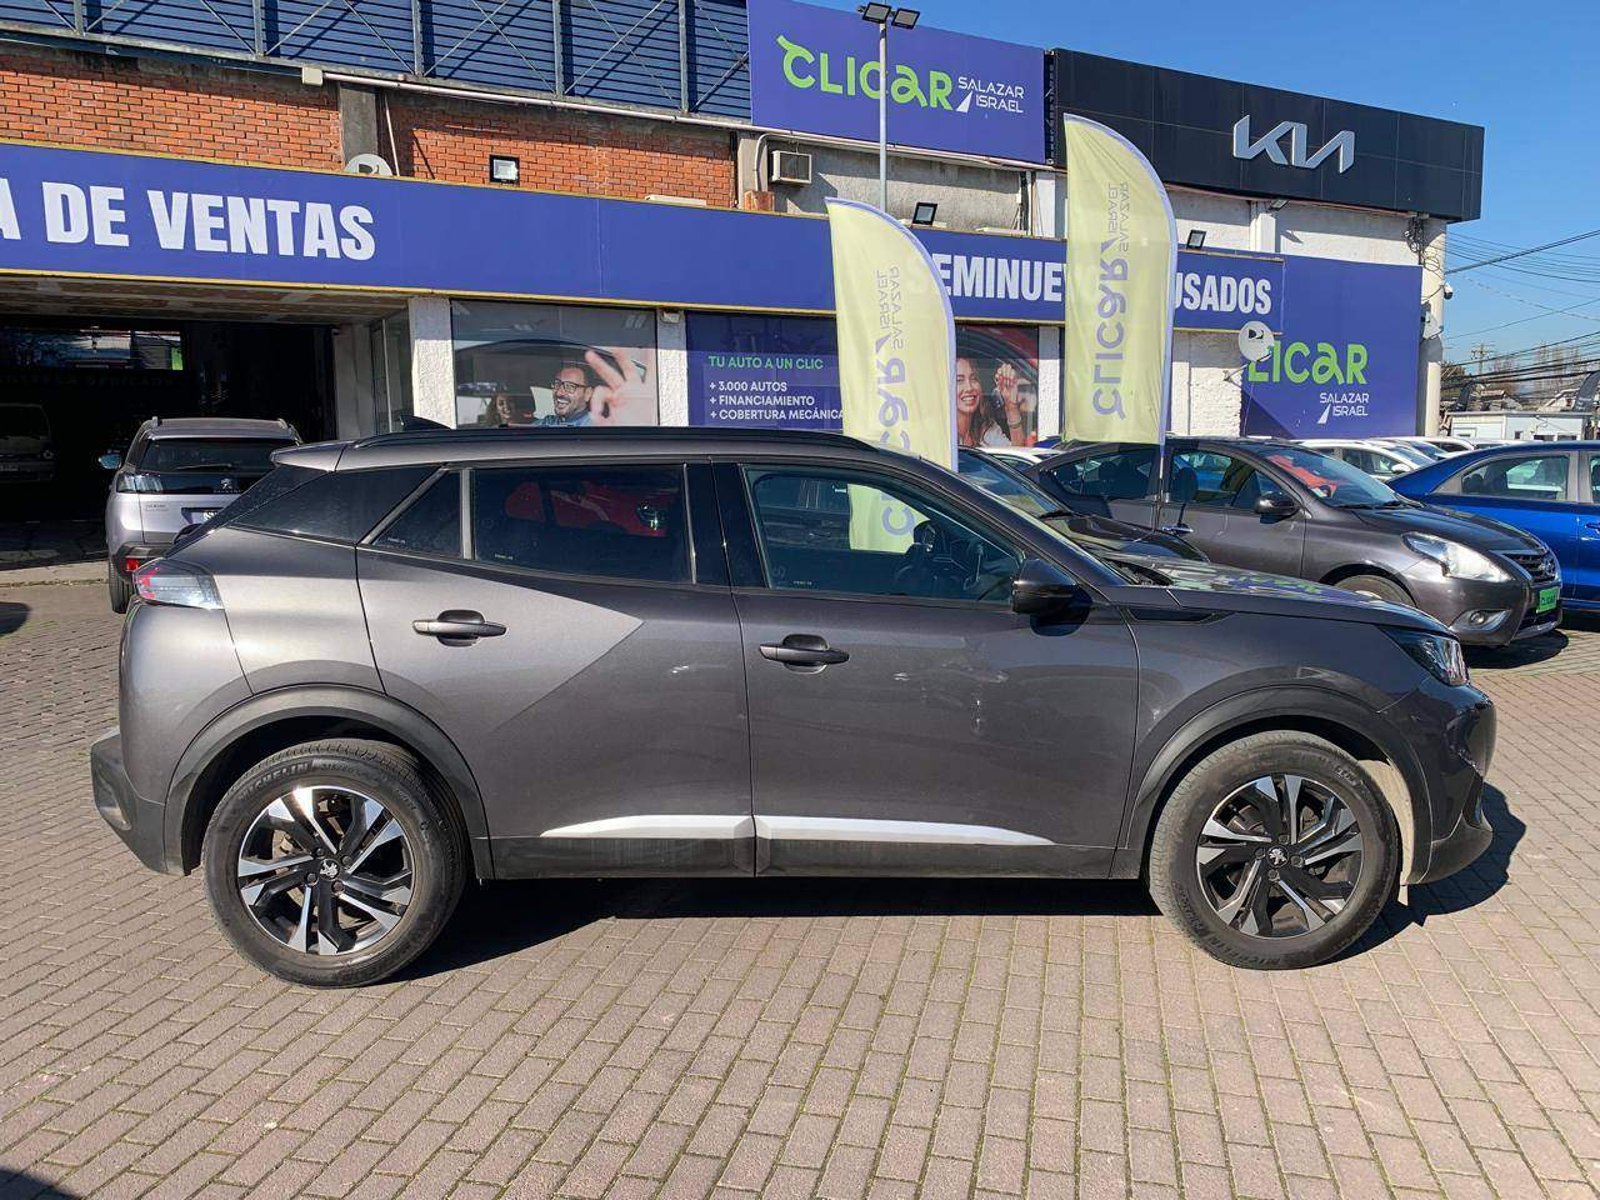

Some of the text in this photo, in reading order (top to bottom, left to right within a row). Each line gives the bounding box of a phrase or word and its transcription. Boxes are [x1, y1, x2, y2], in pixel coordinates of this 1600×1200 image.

[958, 76, 1024, 99] SALAZAR
[976, 93, 1023, 113] ISRAEL
[1233, 115, 1355, 173] KIA
[42, 182, 129, 247] DE
[147, 190, 375, 261] VENTAS
[932, 253, 1066, 302] EMINUE
[708, 356, 823, 369] TU AUTO A UN CLIC
[719, 381, 748, 391] 3.000
[750, 381, 788, 392] AUTOS
[719, 395, 815, 406] FINANCIAMIENTO
[1320, 393, 1369, 404] SALAZAR
[719, 409, 786, 420] COBERTURA
[1333, 405, 1368, 416] ISRAEL
